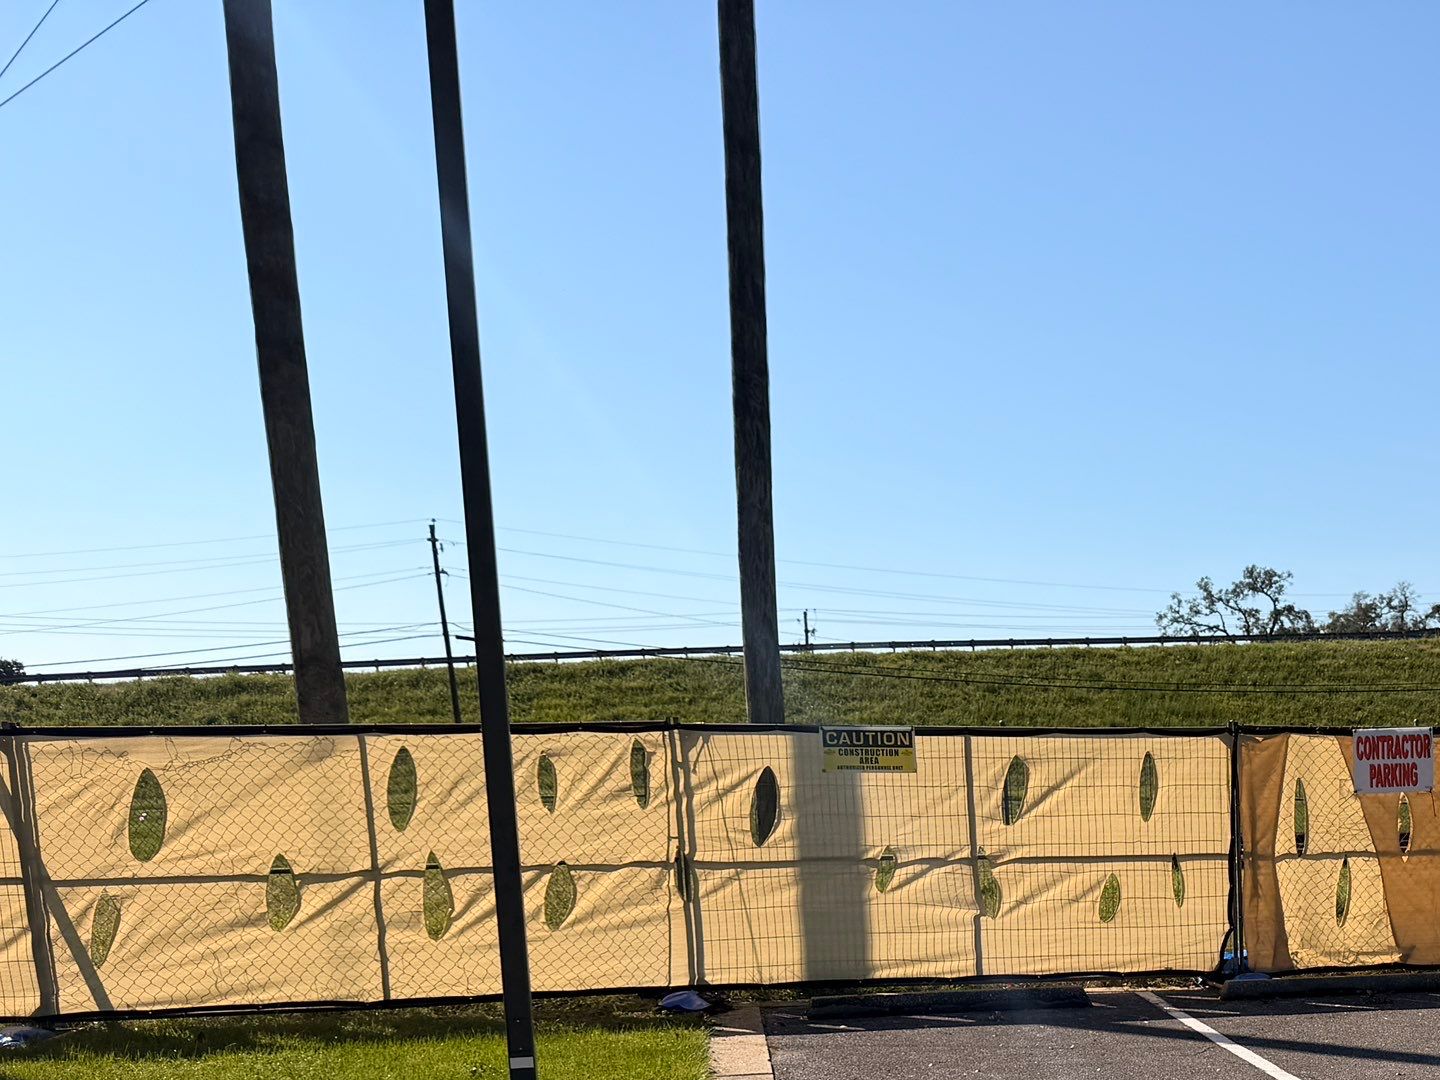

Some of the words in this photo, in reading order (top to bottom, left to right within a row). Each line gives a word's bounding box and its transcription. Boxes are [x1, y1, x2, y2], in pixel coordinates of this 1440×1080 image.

[826, 731, 910, 745] CAUTION
[838, 748, 899, 757] CONSTRUCTION
[1356, 733, 1431, 761] CONTRACTOR
[859, 757, 880, 765] AREA
[1369, 762, 1419, 788] PARKING
